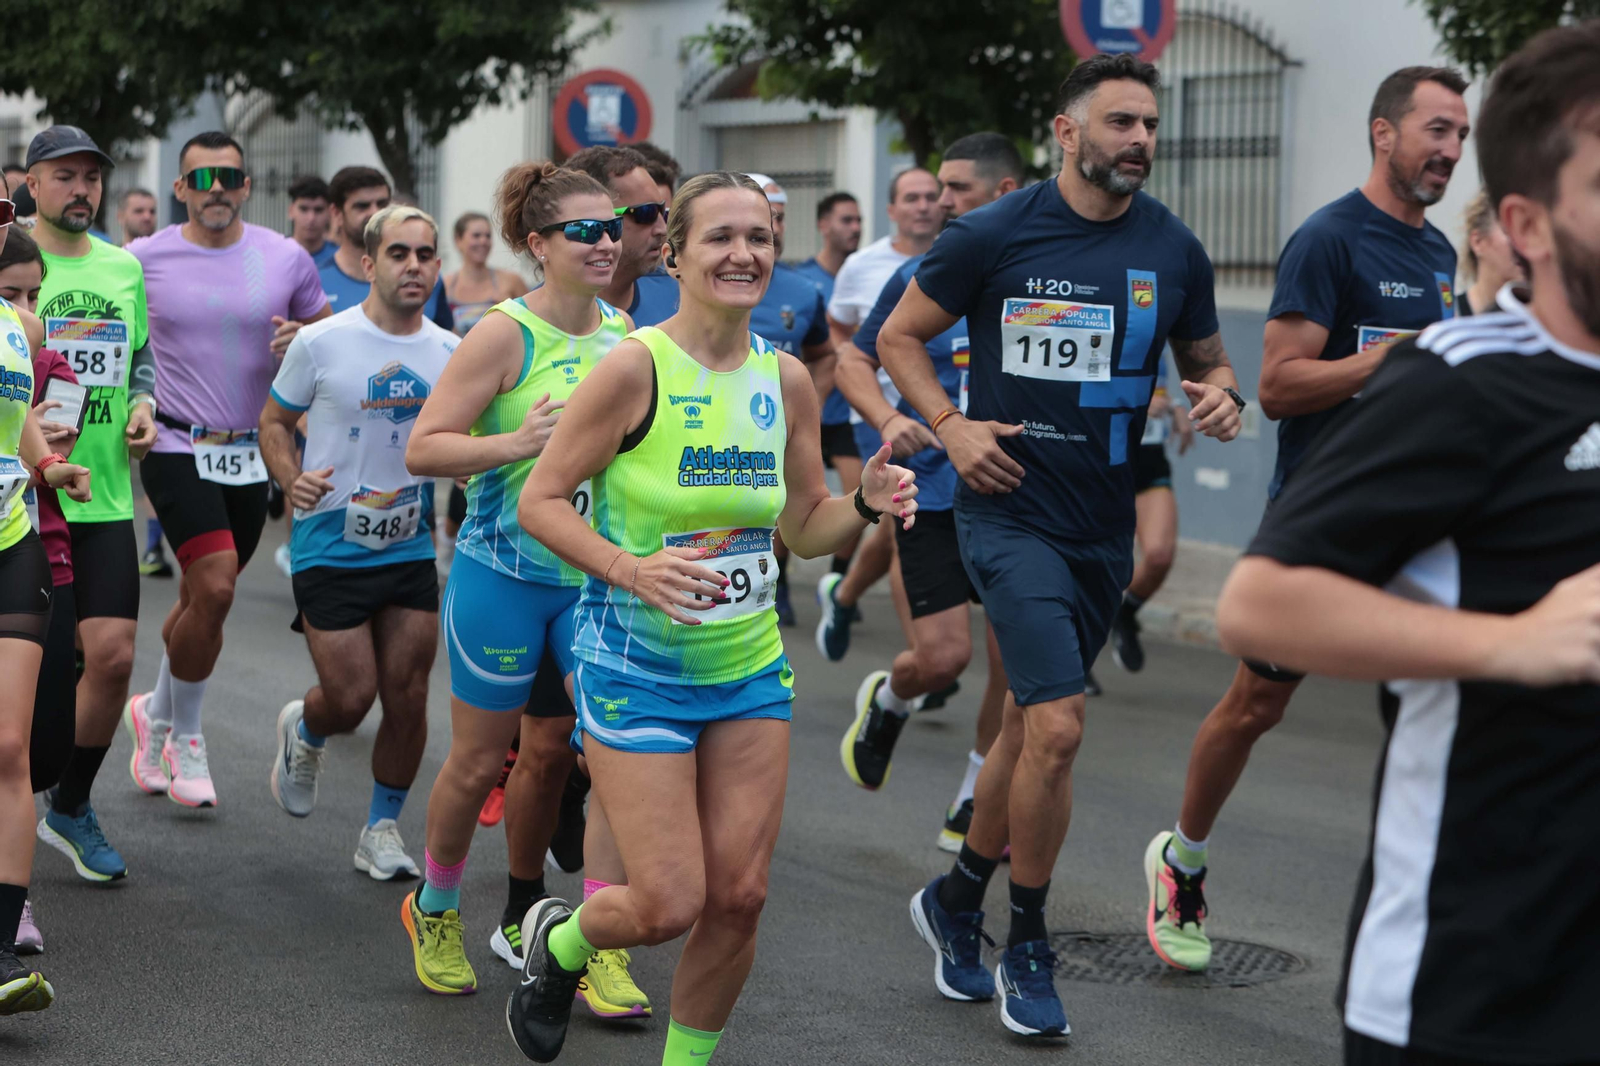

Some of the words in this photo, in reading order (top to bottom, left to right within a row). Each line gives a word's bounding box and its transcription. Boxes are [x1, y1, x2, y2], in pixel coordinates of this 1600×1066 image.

[1012, 306, 1057, 316] CARRERA
[1060, 310, 1104, 320] POPULAR
[91, 326, 123, 334] POPULAR
[1017, 336, 1078, 368] 119
[11, 384, 30, 404] Jerez
[389, 379, 416, 398] 5K
[86, 399, 112, 424] TA
[368, 407, 394, 419] 2025
[1021, 420, 1031, 429] Tu
[1032, 421, 1056, 432] futuro,
[1029, 429, 1066, 440] logramos
[203, 453, 242, 475] 145
[679, 445, 776, 470] Atletismo
[678, 469, 732, 487] Ciudad
[733, 469, 751, 486] de
[751, 469, 779, 490] Jerez
[354, 514, 402, 541] 348
[674, 537, 724, 548] CARRERA
[725, 532, 765, 544] POPULAR
[726, 545, 749, 554] SANTO
[750, 542, 769, 551] ANGEL
